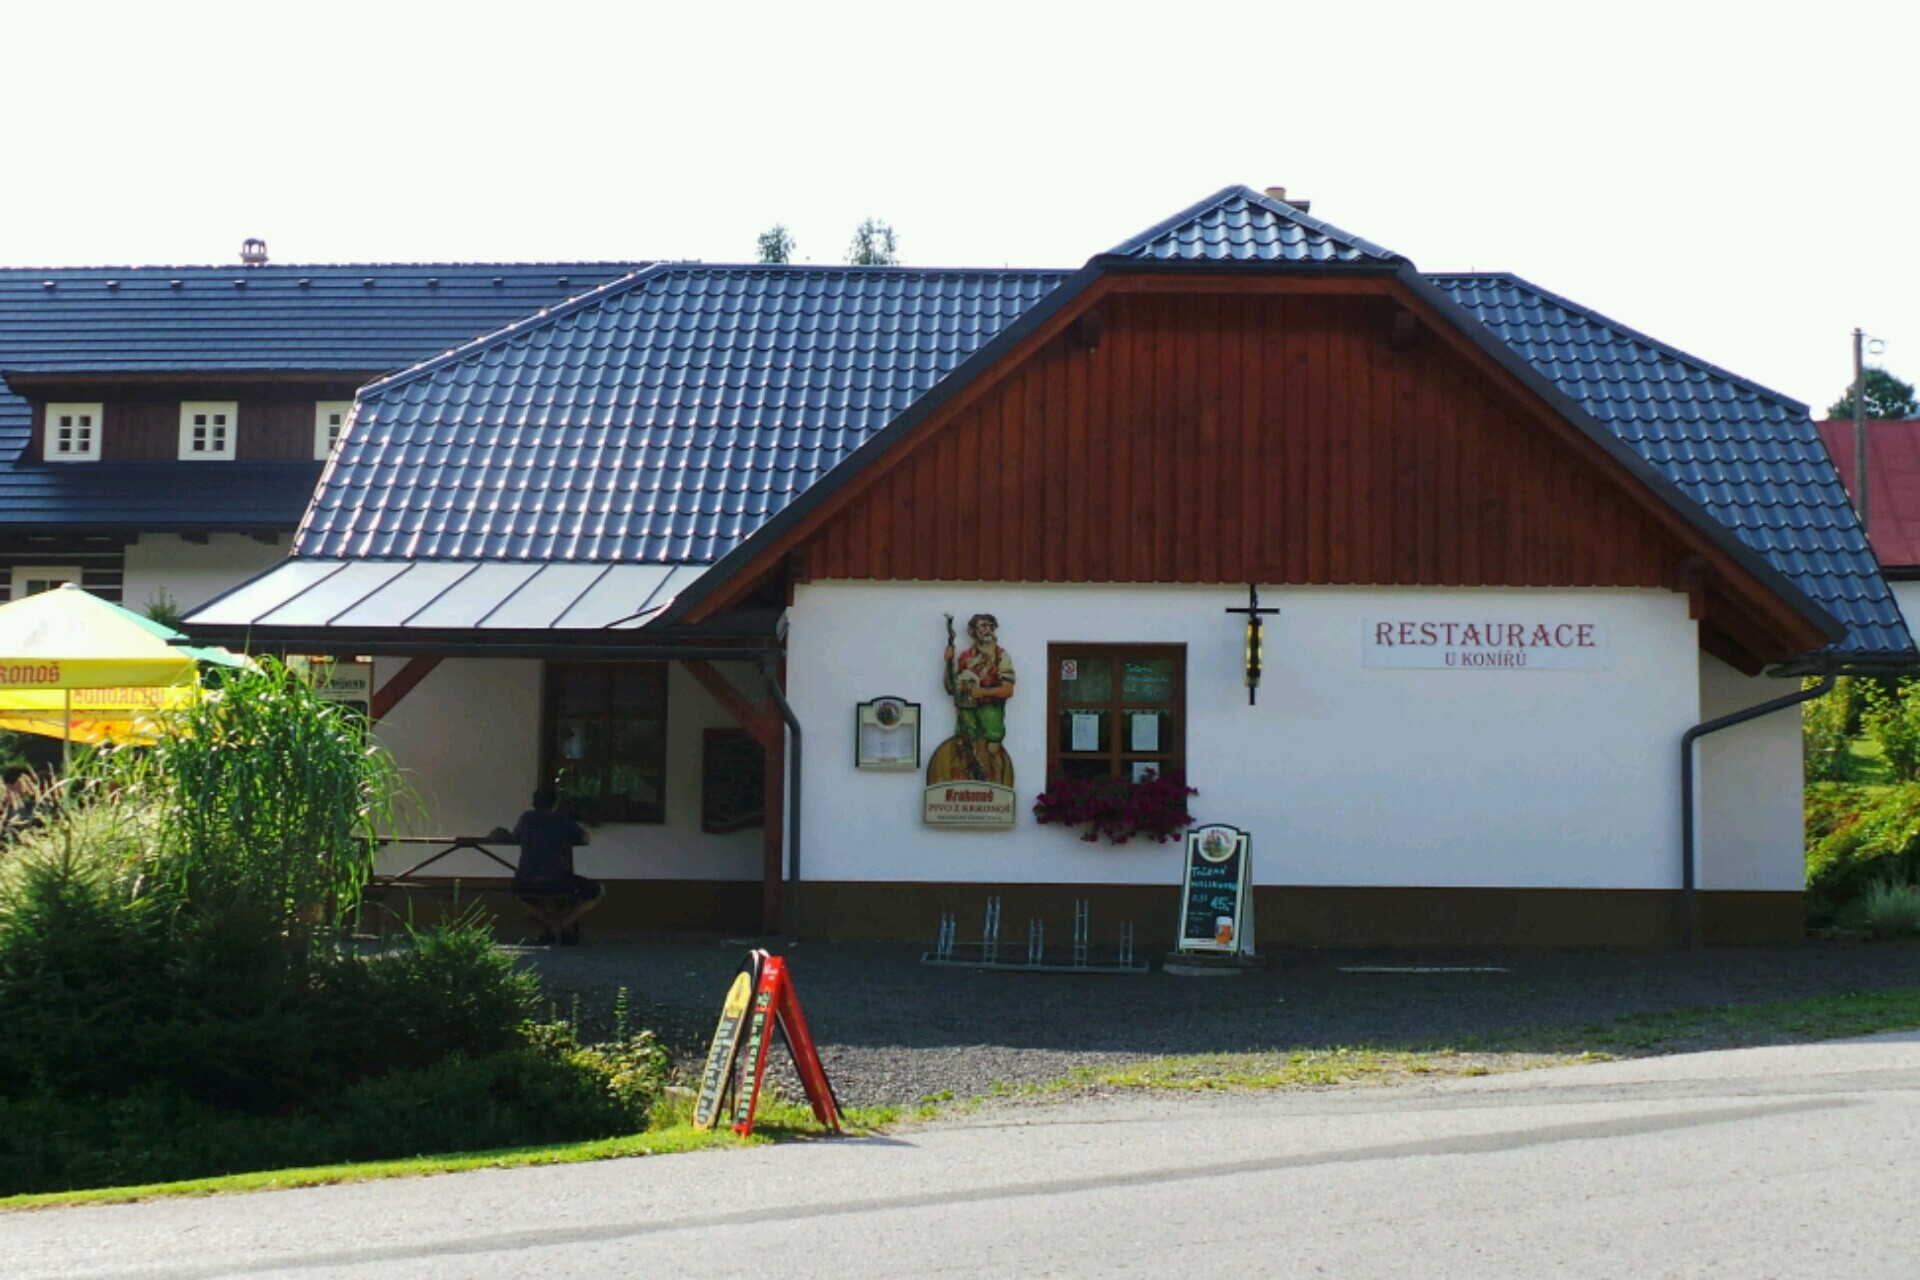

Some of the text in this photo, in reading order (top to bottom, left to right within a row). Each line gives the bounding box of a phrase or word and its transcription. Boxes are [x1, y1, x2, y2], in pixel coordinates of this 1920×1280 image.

[1375, 622, 1595, 647] RESTAURACE
[1445, 650, 1527, 667] U KONÍŘŮ
